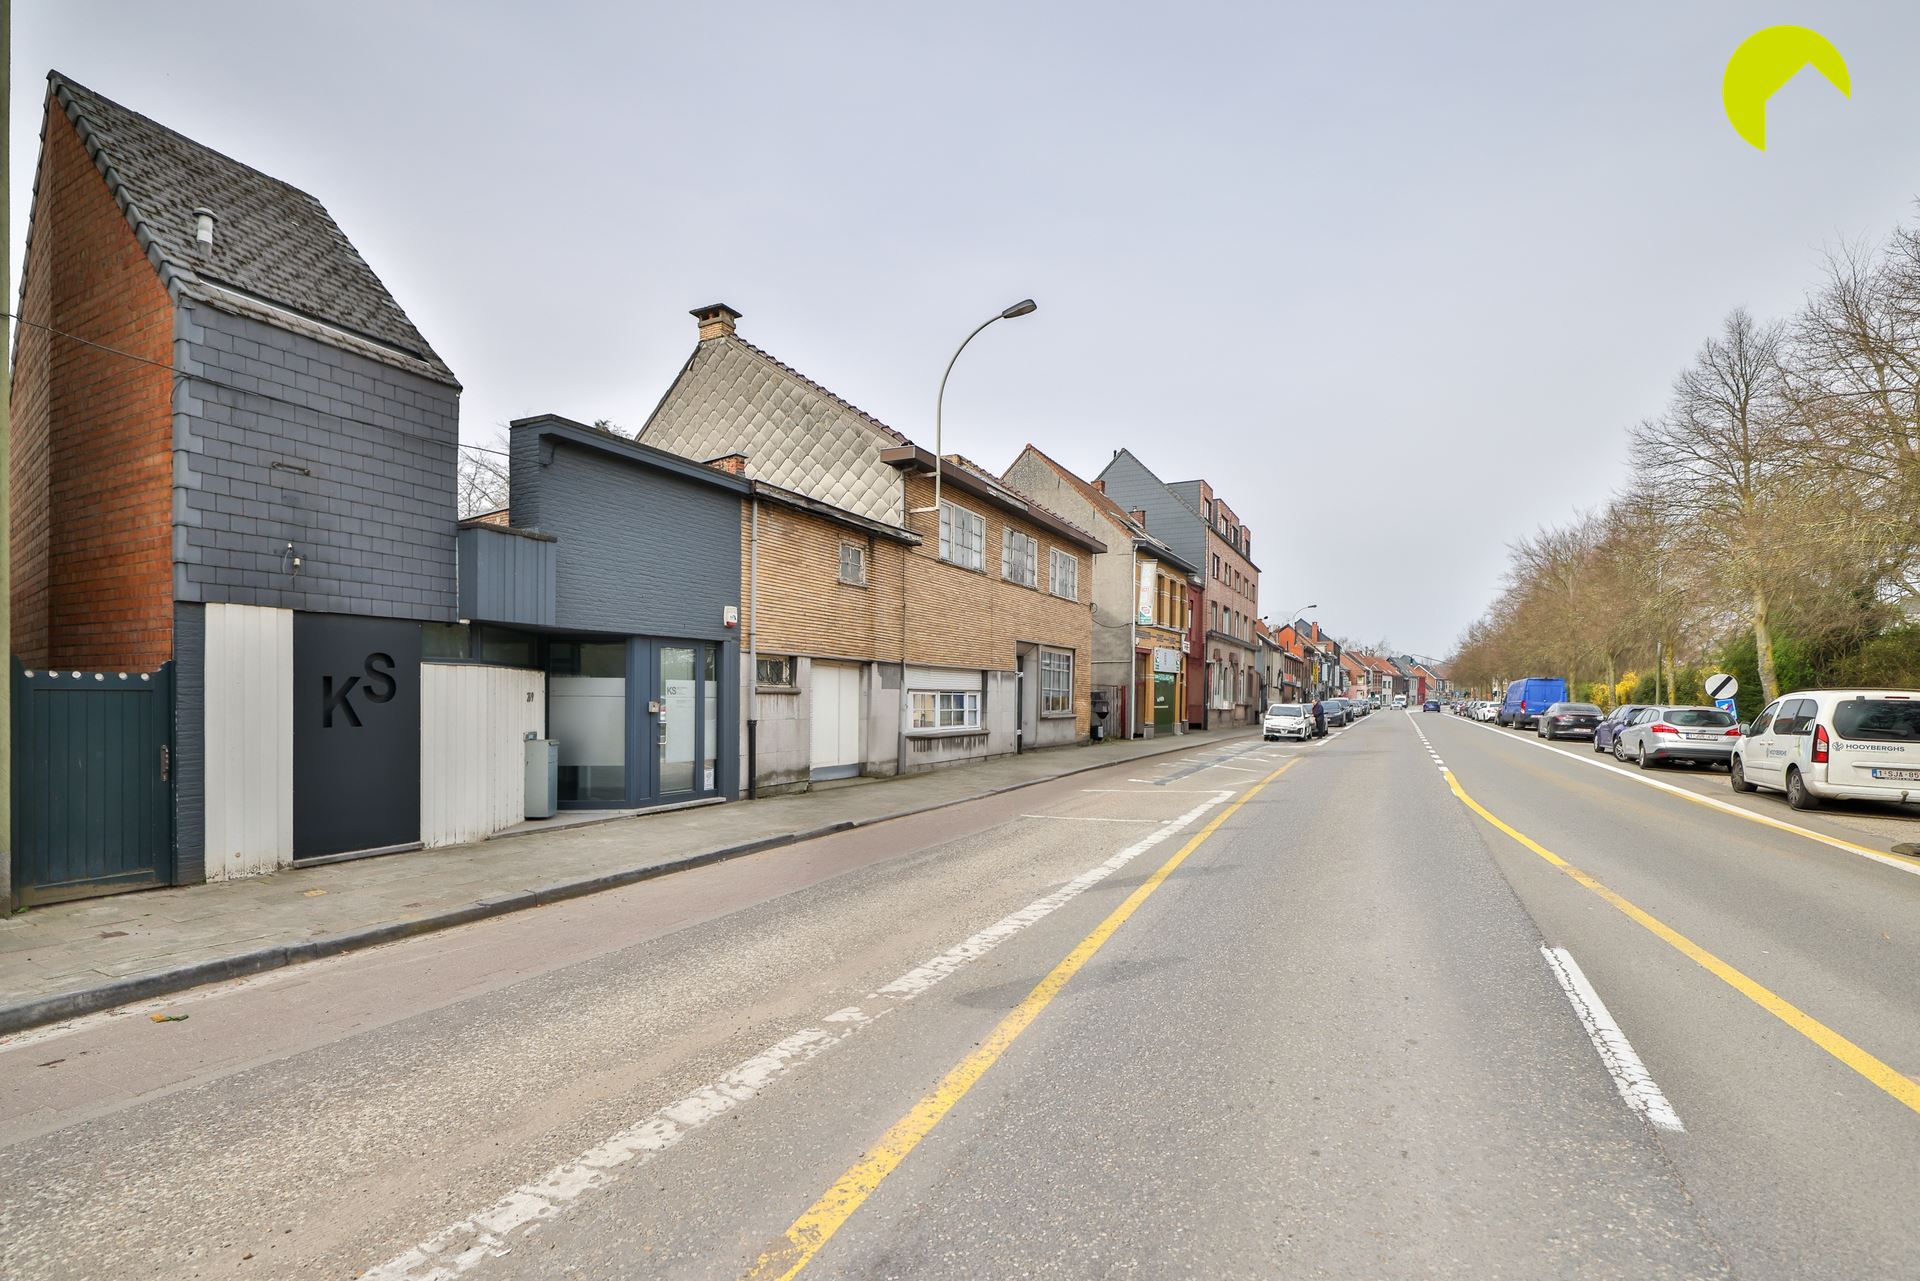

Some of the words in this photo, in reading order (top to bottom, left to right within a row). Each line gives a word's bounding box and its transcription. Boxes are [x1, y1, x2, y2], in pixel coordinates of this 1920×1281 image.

[322, 652, 397, 728] KS
[667, 686, 677, 695] KS
[1846, 744, 1905, 752] HOOYBERGHS
